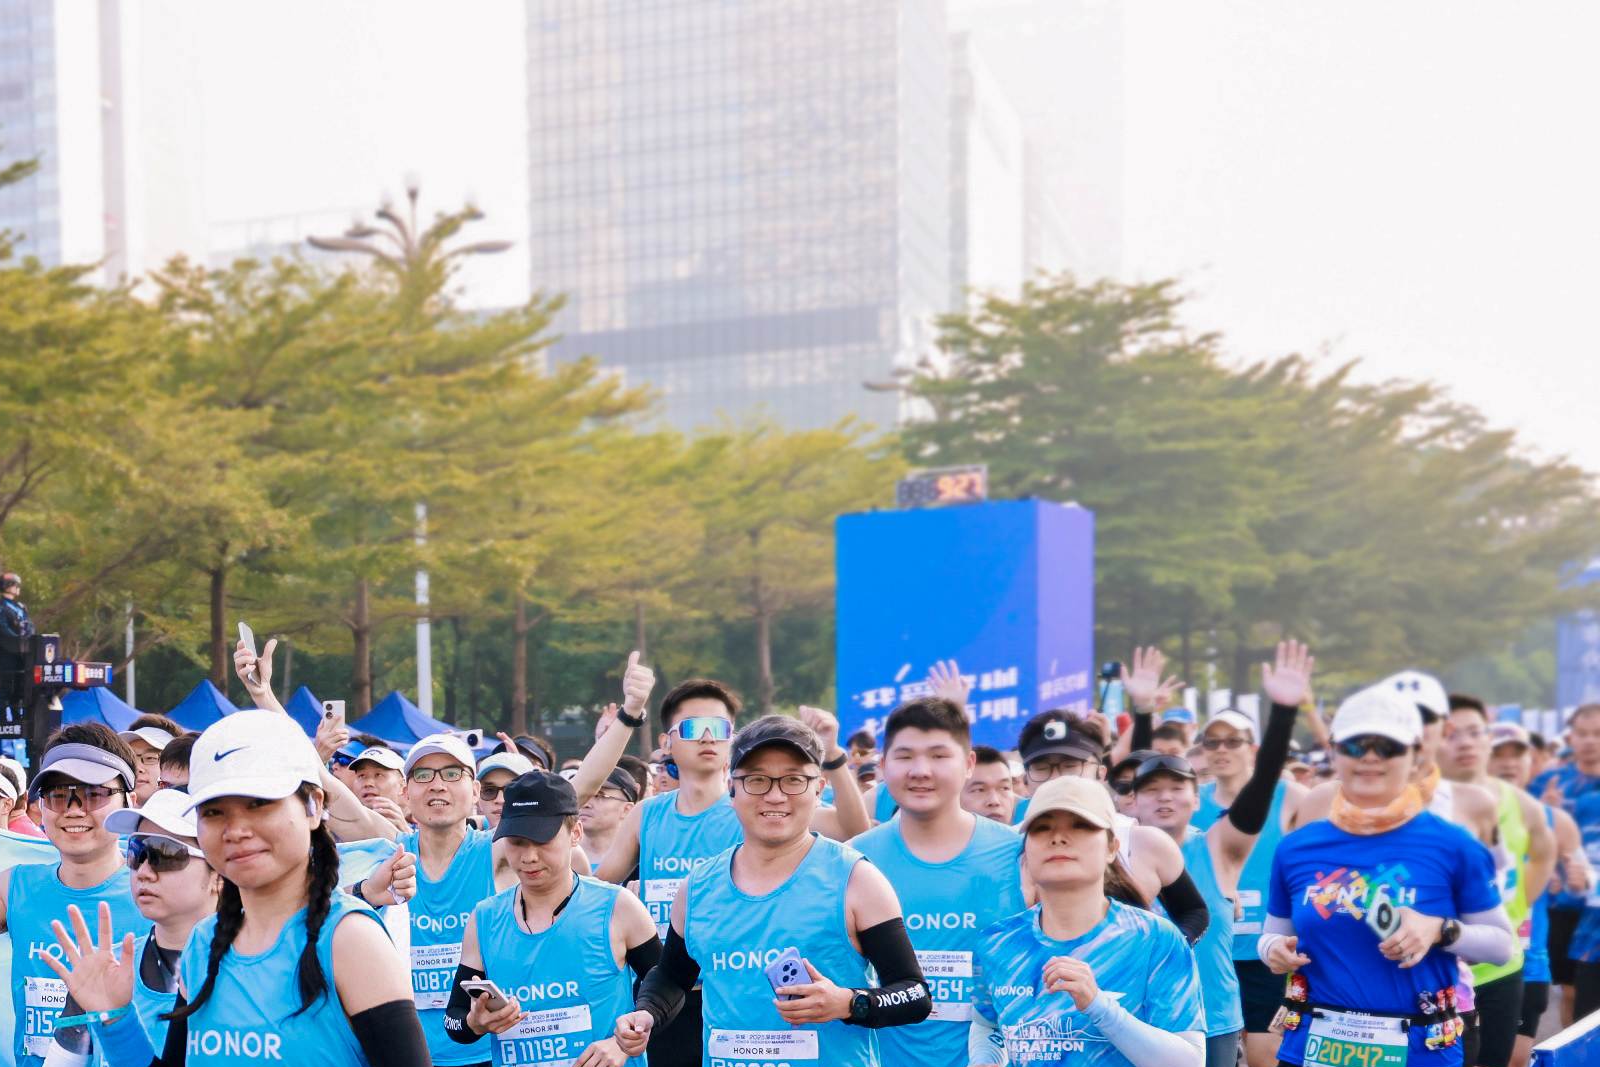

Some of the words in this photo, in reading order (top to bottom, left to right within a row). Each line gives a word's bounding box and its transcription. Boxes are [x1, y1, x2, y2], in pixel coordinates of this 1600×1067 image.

[906, 912, 976, 930] ONOR
[712, 948, 780, 970] HONO
[502, 981, 579, 1002] HONOR
[994, 985, 1034, 996] HONOR
[520, 1025, 546, 1034] HONOR
[1332, 1028, 1360, 1037] HONOR
[188, 1029, 282, 1060] HONOR
[520, 1037, 568, 1062] 11192
